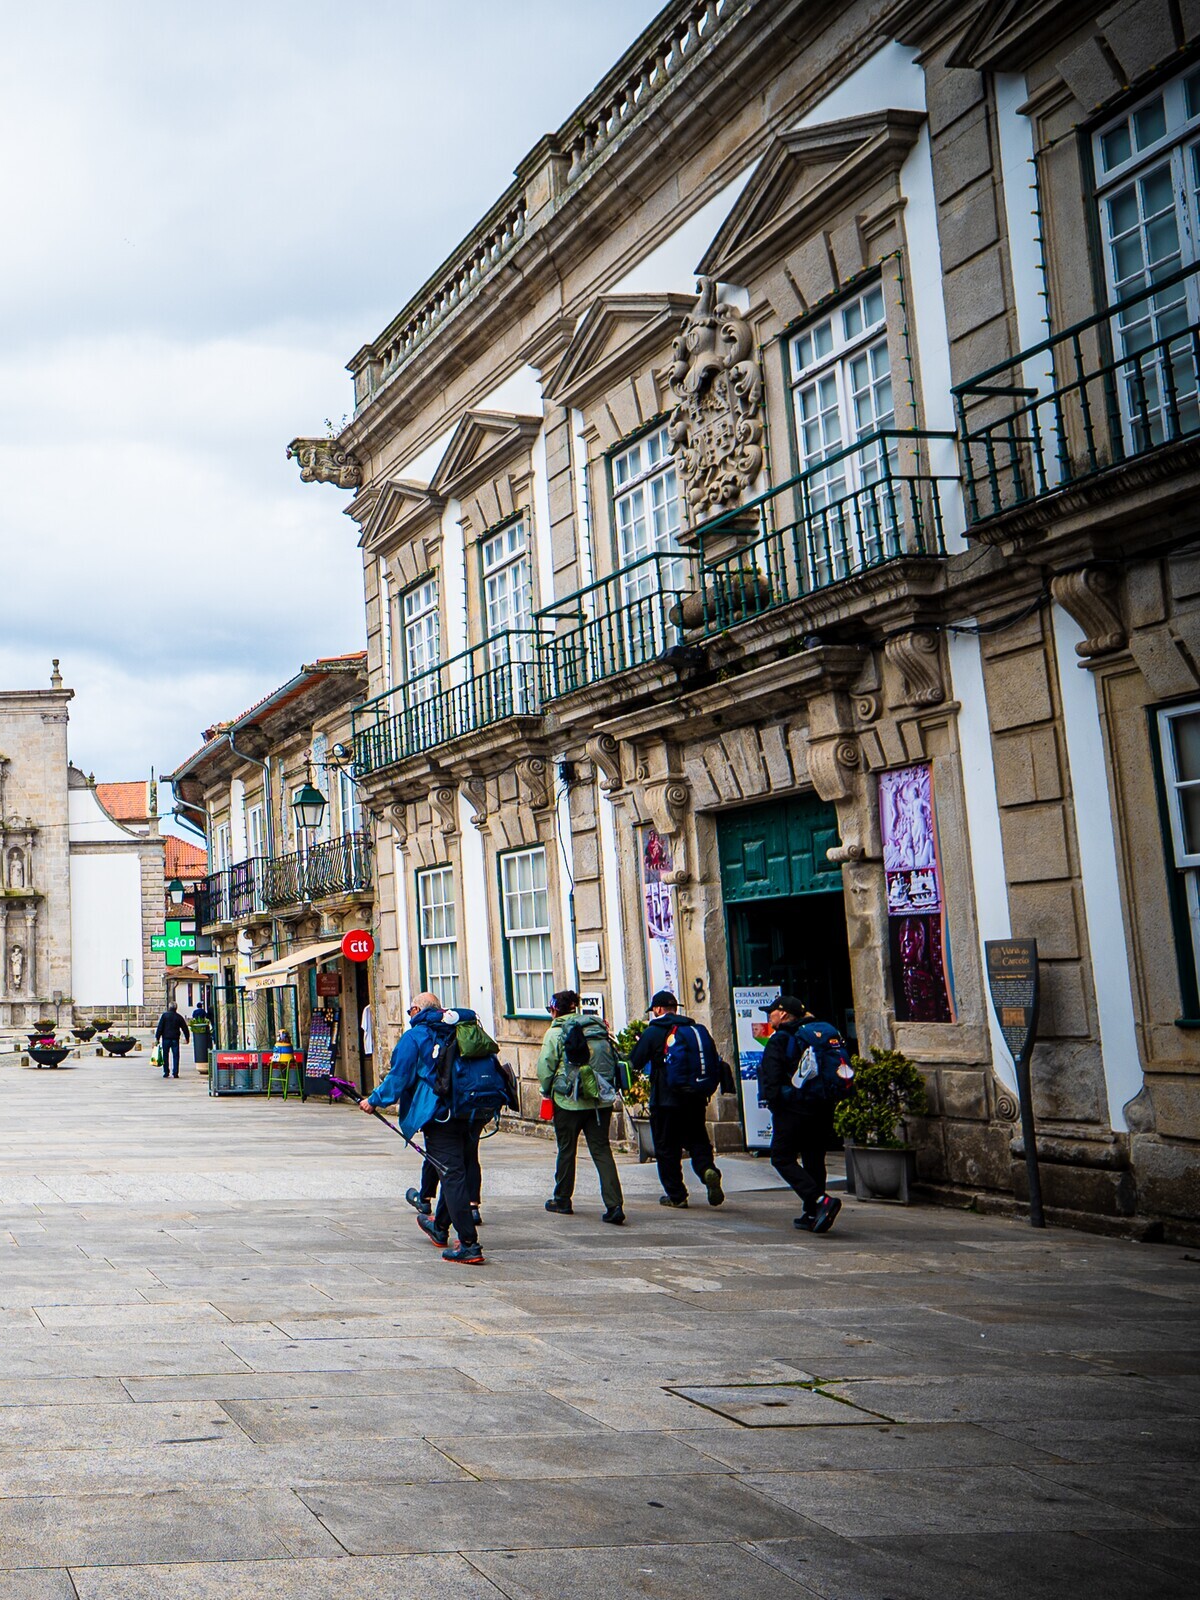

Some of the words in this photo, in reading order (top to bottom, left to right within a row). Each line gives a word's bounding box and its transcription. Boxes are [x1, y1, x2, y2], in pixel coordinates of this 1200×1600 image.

[168, 937, 186, 947] SÃO
[189, 939, 195, 947] D
[350, 940, 369, 952] ctt
